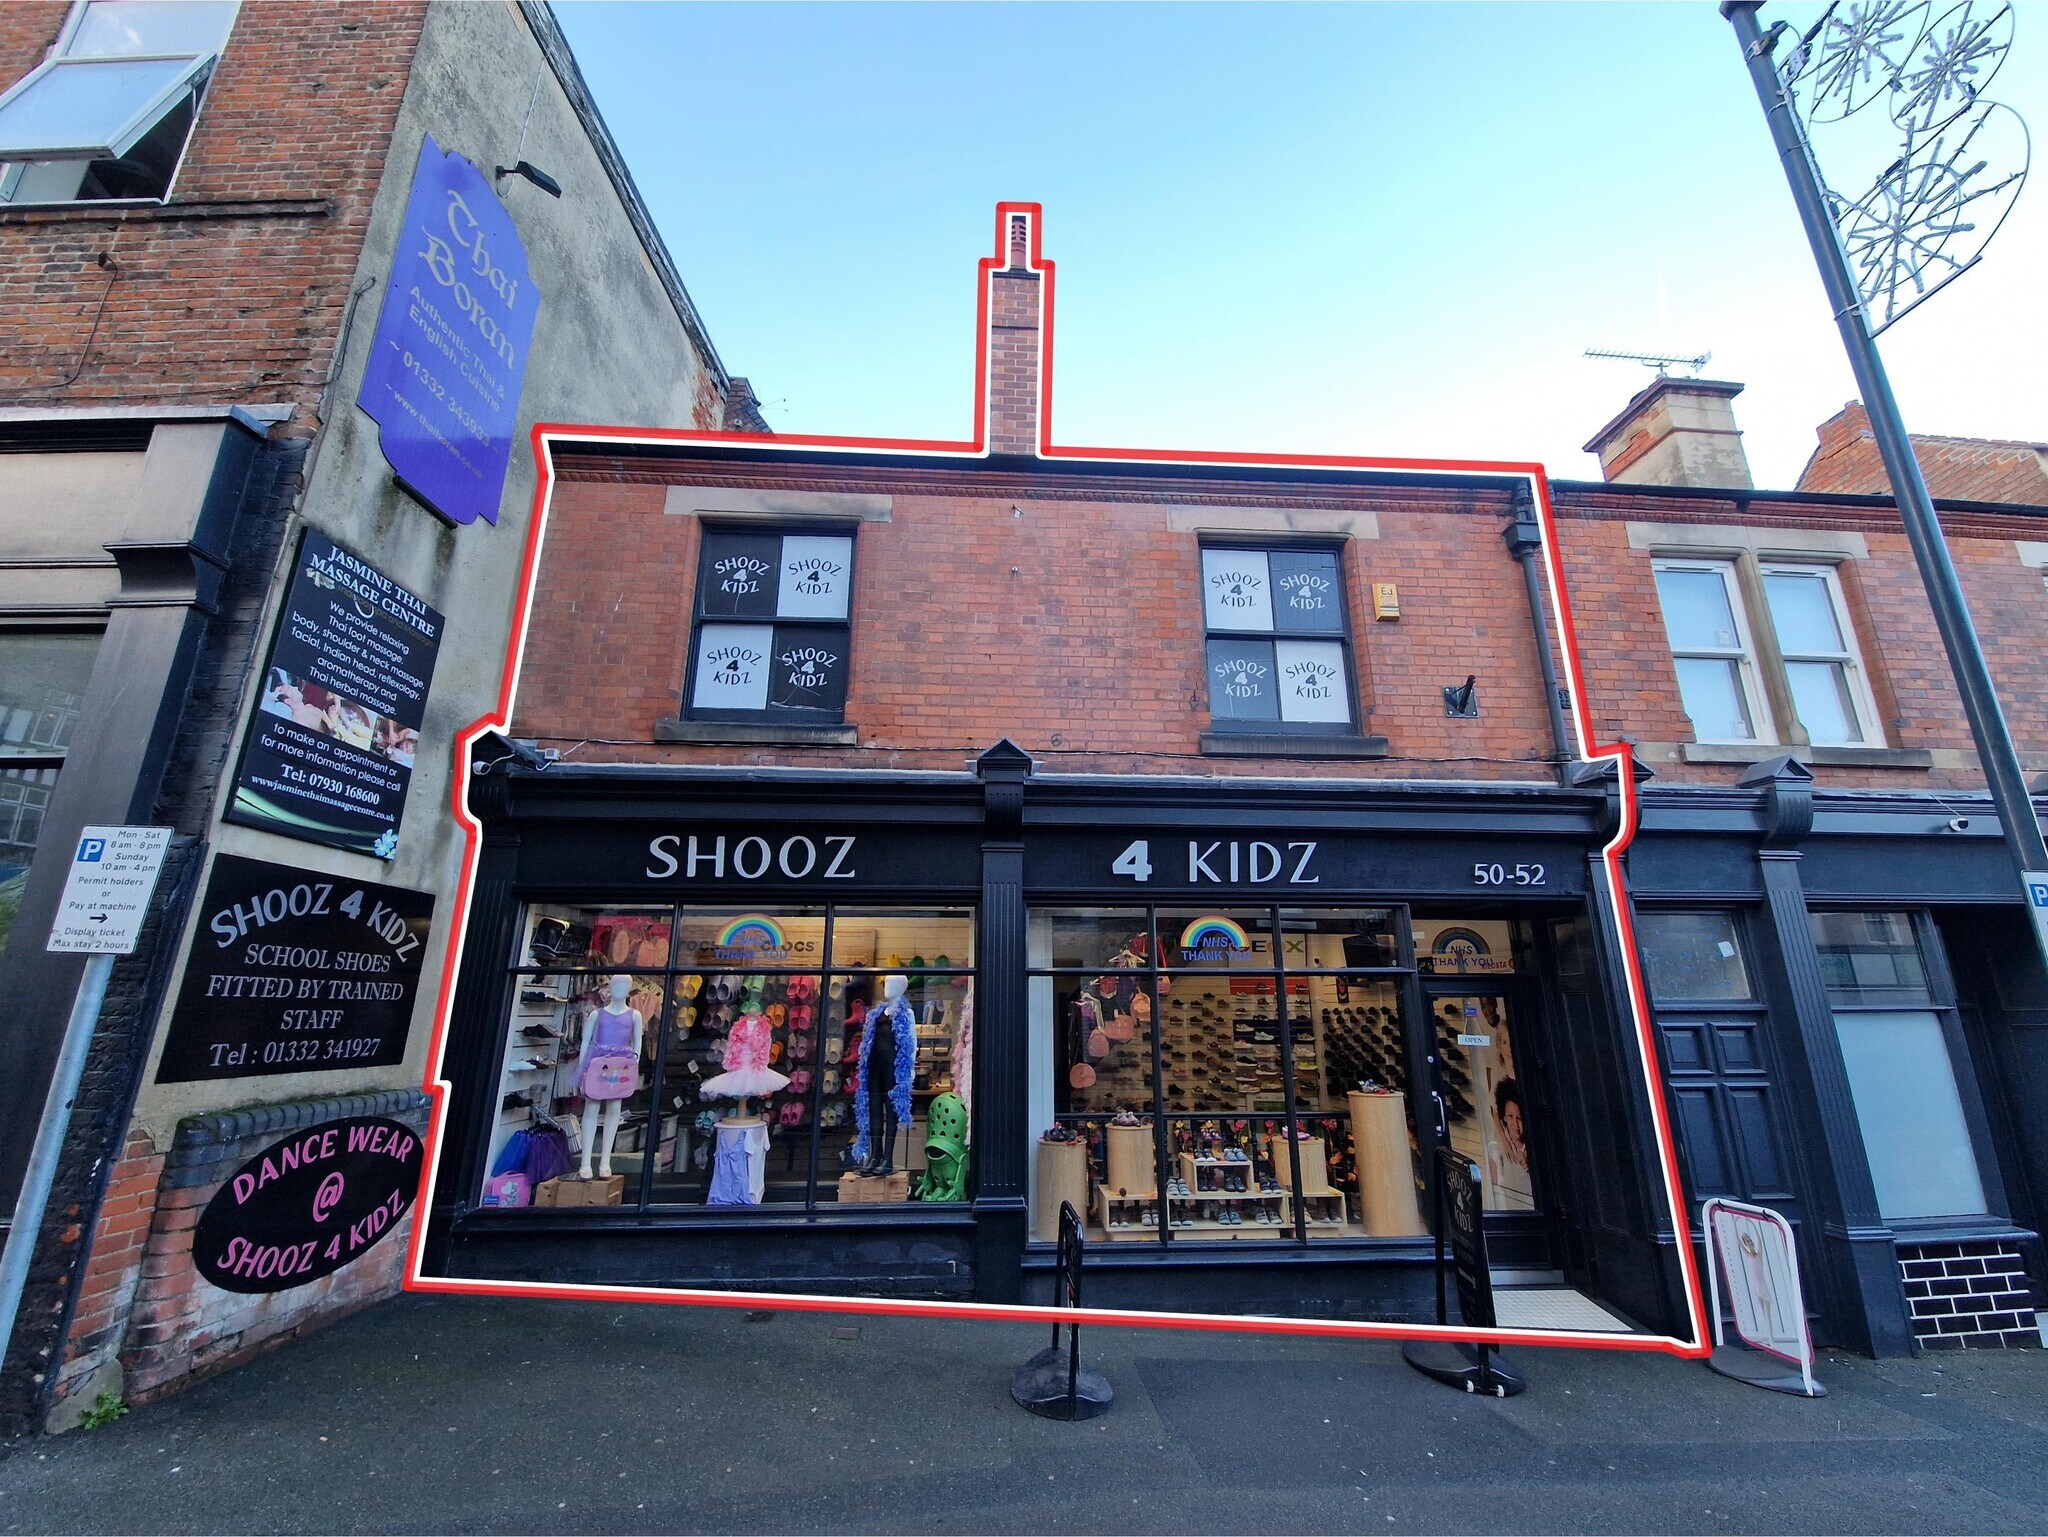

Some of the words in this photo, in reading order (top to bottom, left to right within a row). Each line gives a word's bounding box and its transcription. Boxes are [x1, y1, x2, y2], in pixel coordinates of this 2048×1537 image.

[410, 286, 469, 357] Authentic
[473, 353, 495, 388] Thai
[497, 385, 504, 399] &
[410, 304, 457, 364] English
[461, 362, 500, 412] Cuisine
[403, 352, 445, 401] 01332
[714, 556, 770, 576] SHOOZ
[733, 569, 747, 581] 4
[788, 558, 842, 577] SHOOZ
[328, 546, 392, 594] JASMINE
[395, 586, 426, 615] THAI
[807, 570, 820, 582] 4
[1211, 571, 1262, 590] SHOOZ
[1279, 573, 1330, 592] SHOOZ
[310, 553, 379, 604] MASSAGE
[382, 598, 434, 637] CENTRE
[721, 579, 760, 594] KIDZ
[795, 581, 832, 595] KIDZ
[1230, 584, 1243, 595] 4
[1299, 586, 1311, 597] 4
[1221, 595, 1256, 607] KIDZ
[1289, 596, 1326, 610] KIDZ
[330, 601, 344, 616] We
[346, 612, 378, 636] provide
[379, 630, 409, 655] relaxing
[329, 615, 347, 629] Thai
[348, 626, 366, 642] foot
[367, 639, 404, 665] massage,
[292, 611, 320, 634] body,
[322, 628, 360, 654] shoulder
[361, 649, 368, 659] &
[370, 654, 390, 670] neck
[391, 666, 425, 690] massage,
[707, 646, 762, 666] SHOOZ
[781, 647, 838, 668] SHOOZ
[291, 627, 321, 650] facial,
[323, 643, 351, 664] Indian
[352, 658, 377, 678] head,
[378, 673, 421, 701] reflexology,
[726, 660, 739, 671] 4
[800, 660, 815, 674] 4
[1214, 660, 1268, 679] SHOOZ
[1285, 661, 1336, 680] SHOOZ
[317, 657, 380, 693] aromatherapy
[381, 688, 397, 701] and
[713, 670, 752, 685] KIDZ
[789, 672, 828, 687] KIDZ
[1235, 672, 1248, 685] 4
[1305, 674, 1318, 686] 4
[310, 666, 329, 682] Thai
[330, 676, 358, 697] herbal
[360, 692, 397, 715] massage.
[1225, 683, 1262, 698] KIDZ
[1296, 685, 1332, 699] KIDZ
[274, 722, 285, 734] to
[287, 729, 314, 746] make
[317, 740, 329, 752] an
[333, 747, 389, 775] appointment
[389, 768, 398, 777] or
[261, 734, 276, 748] for
[278, 742, 305, 757] more
[305, 750, 357, 776] information
[358, 771, 385, 787] please
[387, 780, 401, 792] call
[281, 763, 307, 783] Tel:
[310, 773, 342, 794] 07930
[344, 785, 380, 805] 168600
[144, 831, 160, 839] Sat
[83, 841, 102, 860] P
[139, 841, 145, 849] 8
[147, 843, 161, 851] pm
[115, 853, 149, 861] Sunday
[646, 835, 856, 878] SHOOZ
[1112, 840, 1152, 881] 4
[1189, 841, 1319, 883] KIDZ
[142, 865, 156, 873] pm
[1474, 863, 1546, 885] 50-52
[110, 877, 144, 886] holders
[2034, 886, 2048, 905] P
[69, 902, 85, 910] Pay
[100, 902, 137, 911] machine
[64, 927, 96, 937] Display
[99, 928, 126, 937] ticket
[210, 883, 334, 948] SHOOZ
[339, 890, 365, 919] 4
[366, 900, 420, 963] KIDZ
[53, 939, 71, 947] Max
[74, 940, 92, 949] stay
[104, 940, 129, 949] hours
[1202, 936, 1229, 948] NHS
[1450, 945, 1473, 955] NHS
[244, 943, 331, 969] SCHOOL
[334, 951, 391, 973] SHOES
[1181, 950, 1222, 960] THANK
[1433, 957, 1469, 966] THANK
[1472, 957, 1494, 967] YOU
[205, 975, 293, 998] FITTED
[296, 979, 326, 999] BY
[328, 980, 404, 1000] TRAINED
[280, 1010, 344, 1030] STAFF
[263, 1039, 320, 1063] 01332
[322, 1038, 381, 1060] 341927
[232, 1129, 339, 1205] DANCE
[347, 1126, 414, 1163] WEAR
[313, 1172, 344, 1222] @
[1446, 1169, 1473, 1206] SHOOZ
[1456, 1191, 1464, 1210] 4
[1454, 1204, 1473, 1233] KIDZ
[217, 1236, 318, 1278] SHOOZ
[324, 1234, 341, 1260] 4
[350, 1188, 404, 1250] KIDZ
